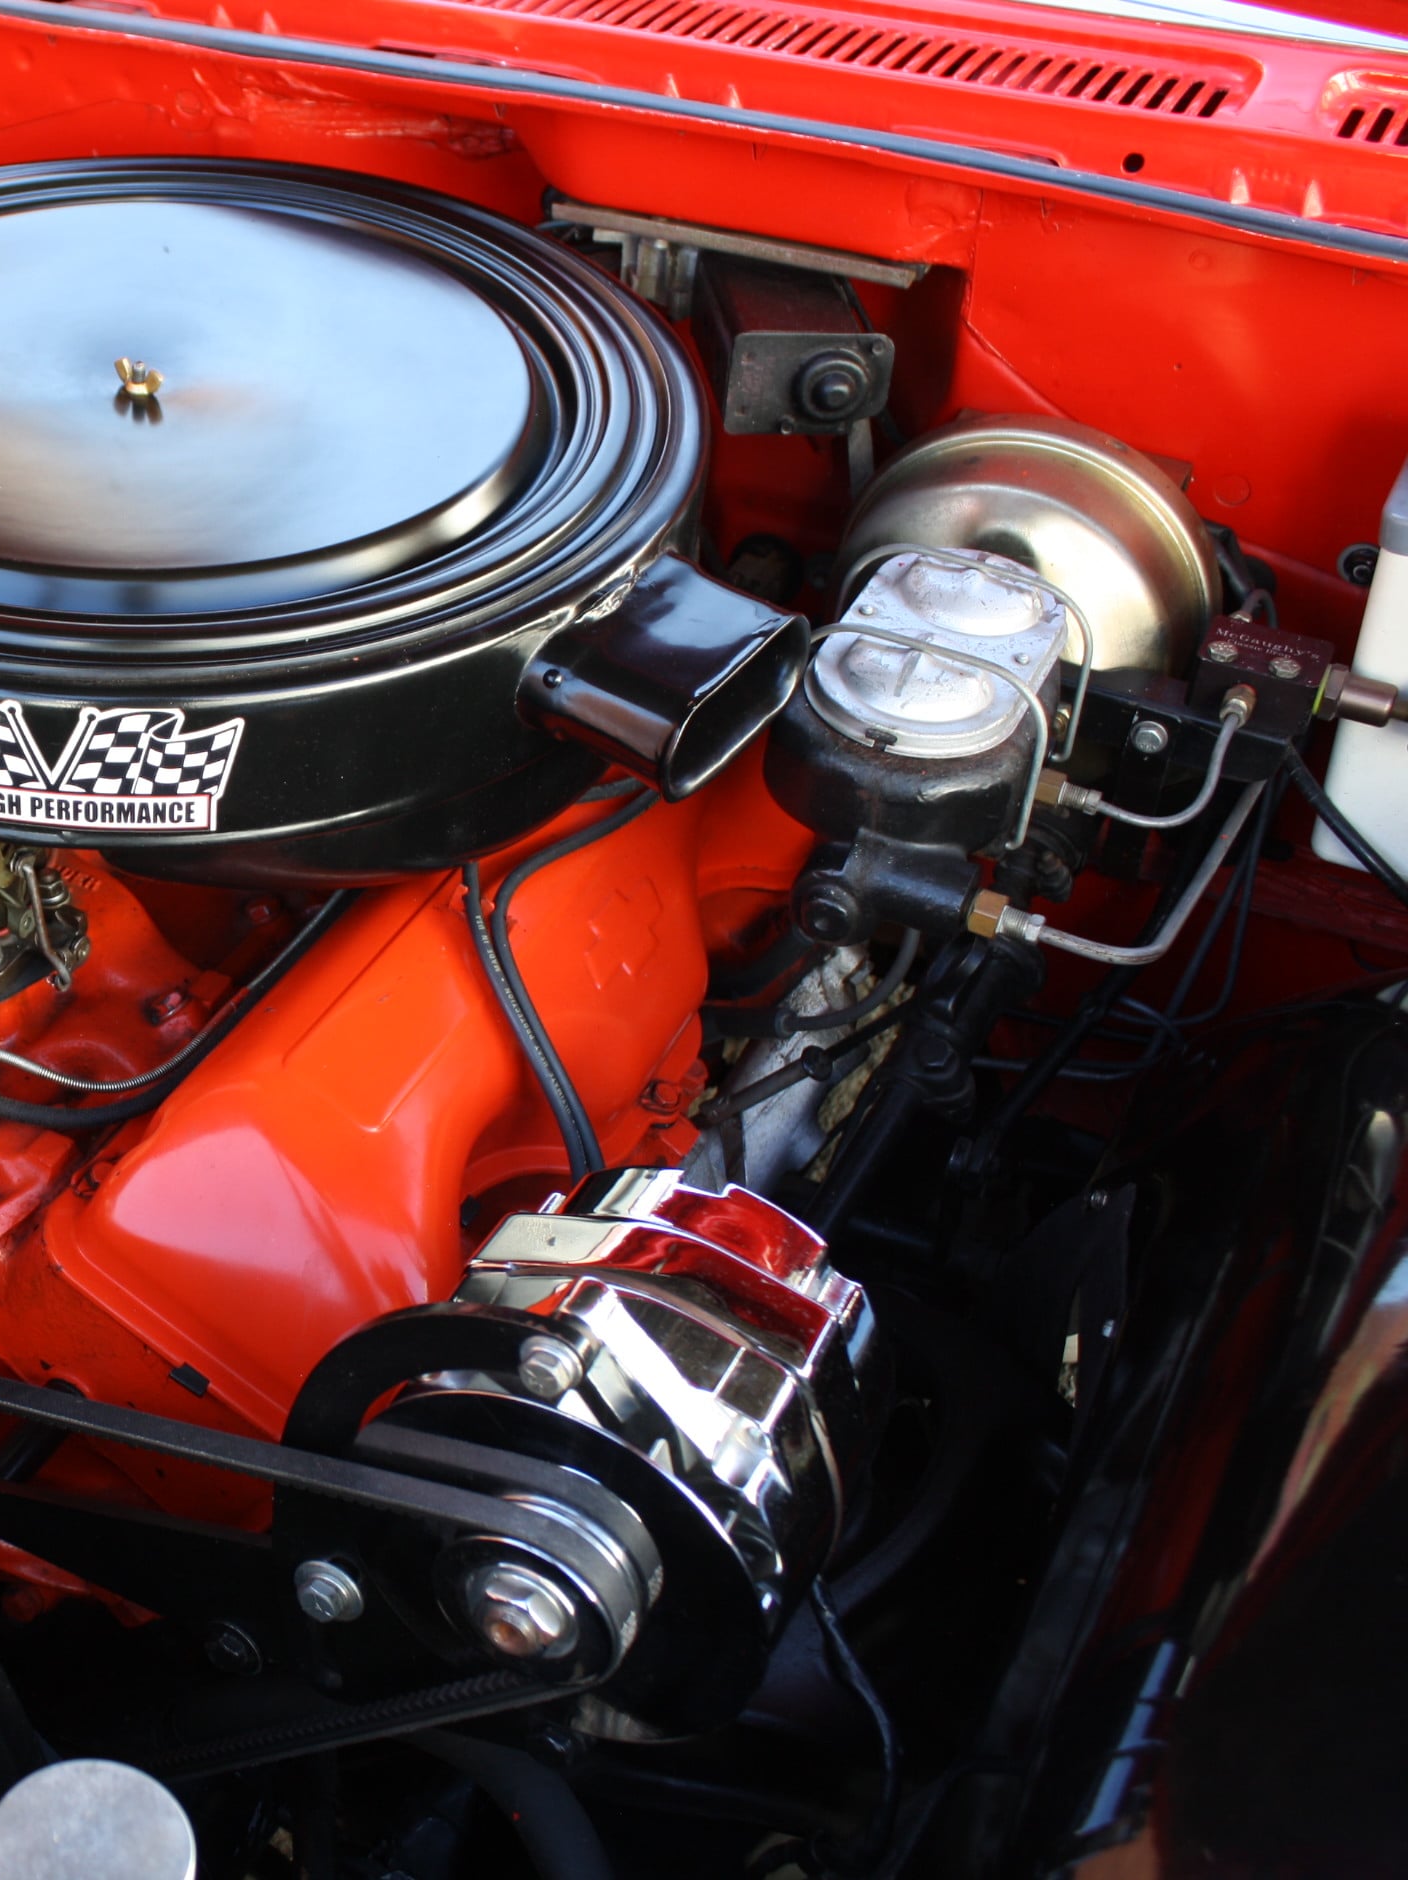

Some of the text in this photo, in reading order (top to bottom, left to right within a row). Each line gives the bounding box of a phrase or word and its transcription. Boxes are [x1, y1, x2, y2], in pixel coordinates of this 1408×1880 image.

[30, 796, 196, 825] PERFORMANCE
[481, 935, 489, 944] IN
[487, 949, 501, 972] MADE
[505, 987, 535, 1040] PROTECTION
